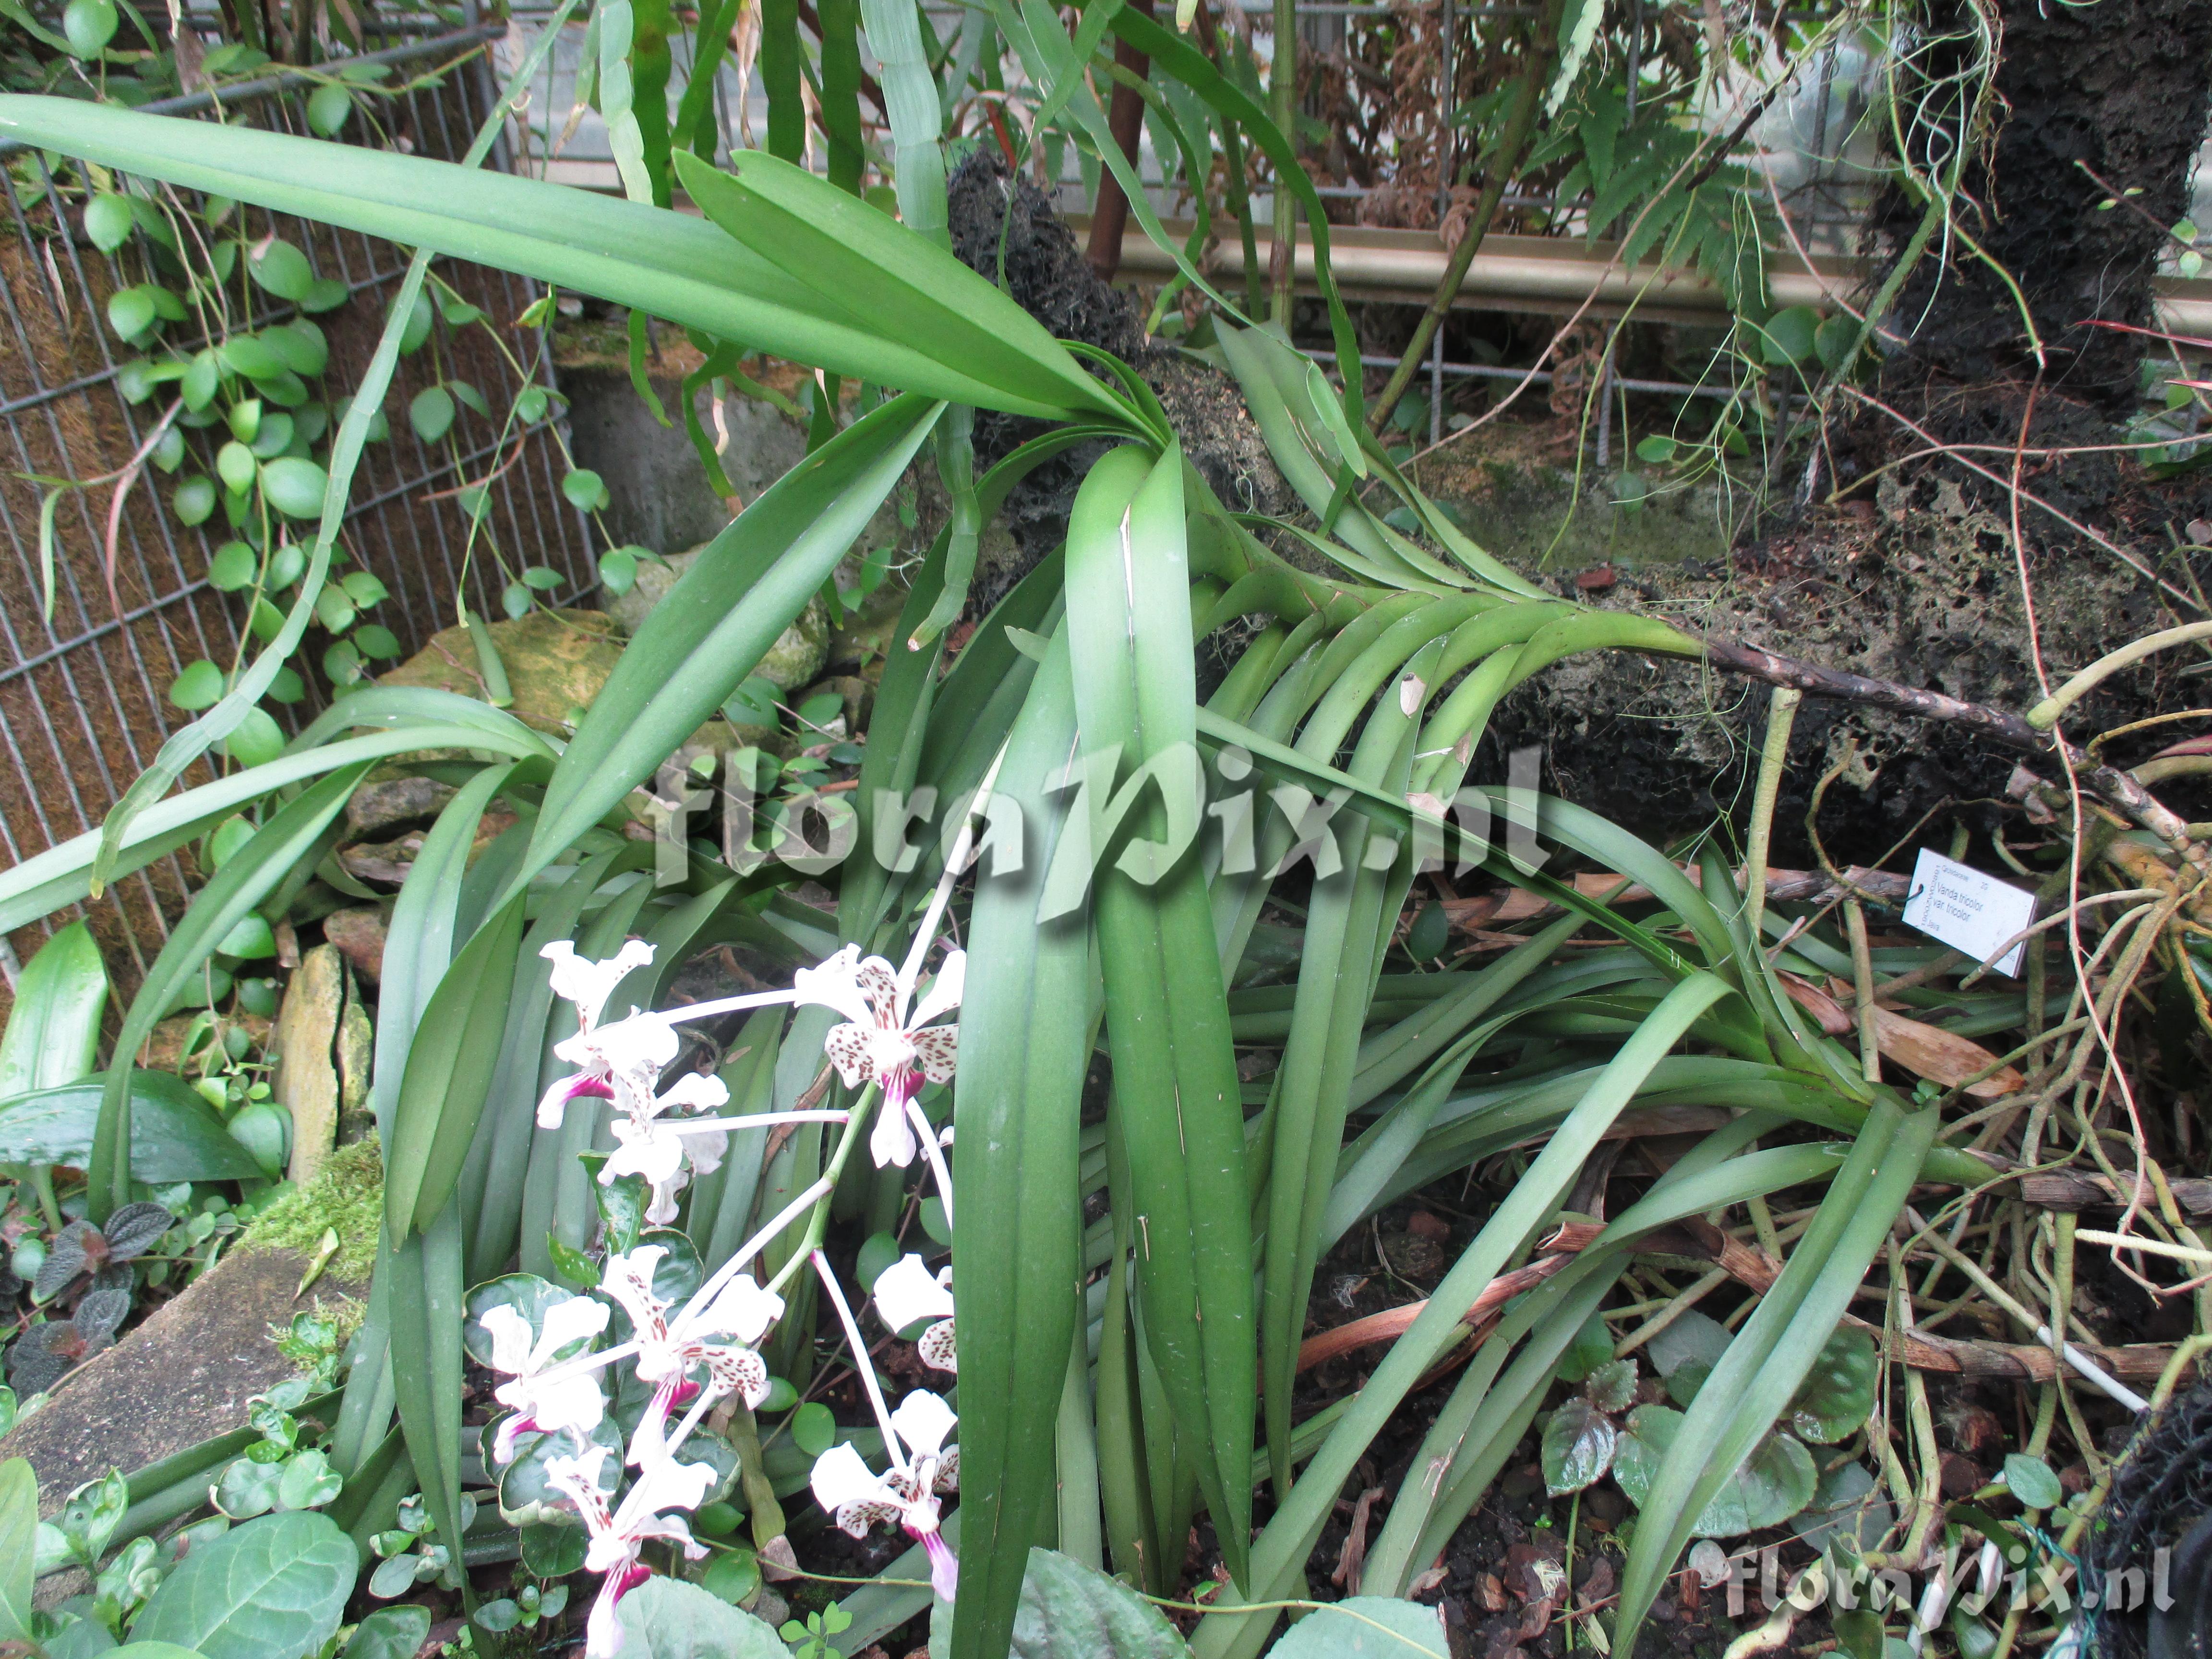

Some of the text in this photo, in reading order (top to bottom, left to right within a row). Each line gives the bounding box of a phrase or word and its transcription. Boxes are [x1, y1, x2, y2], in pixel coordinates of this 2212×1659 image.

[1937, 882, 1984, 912] Vanda tricolor
[1946, 902, 1971, 922] tricolor
